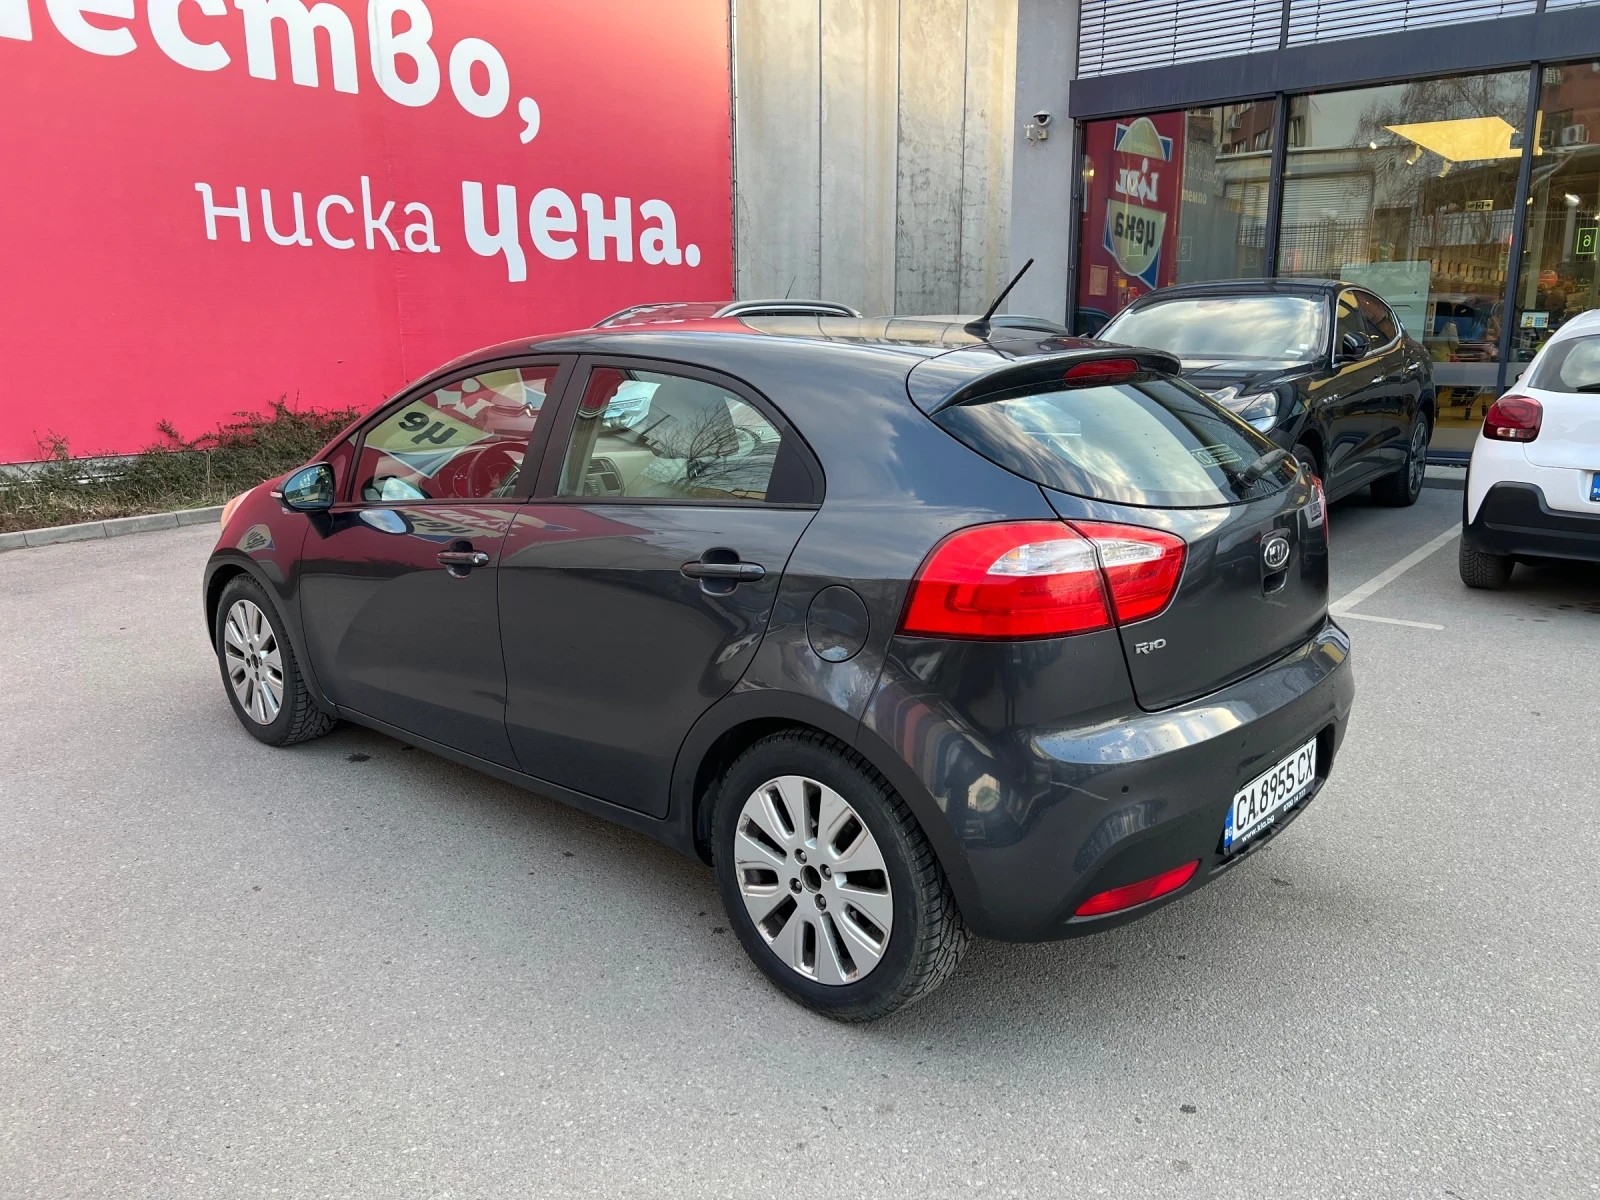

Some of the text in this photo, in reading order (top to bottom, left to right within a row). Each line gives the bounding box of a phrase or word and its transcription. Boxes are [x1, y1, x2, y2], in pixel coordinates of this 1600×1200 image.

[0, 0, 541, 144] ество,
[195, 175, 701, 283] ниска цена.
[1269, 543, 1286, 564] KIA
[1134, 638, 1167, 655] RIO
[1224, 826, 1233, 840] BG
